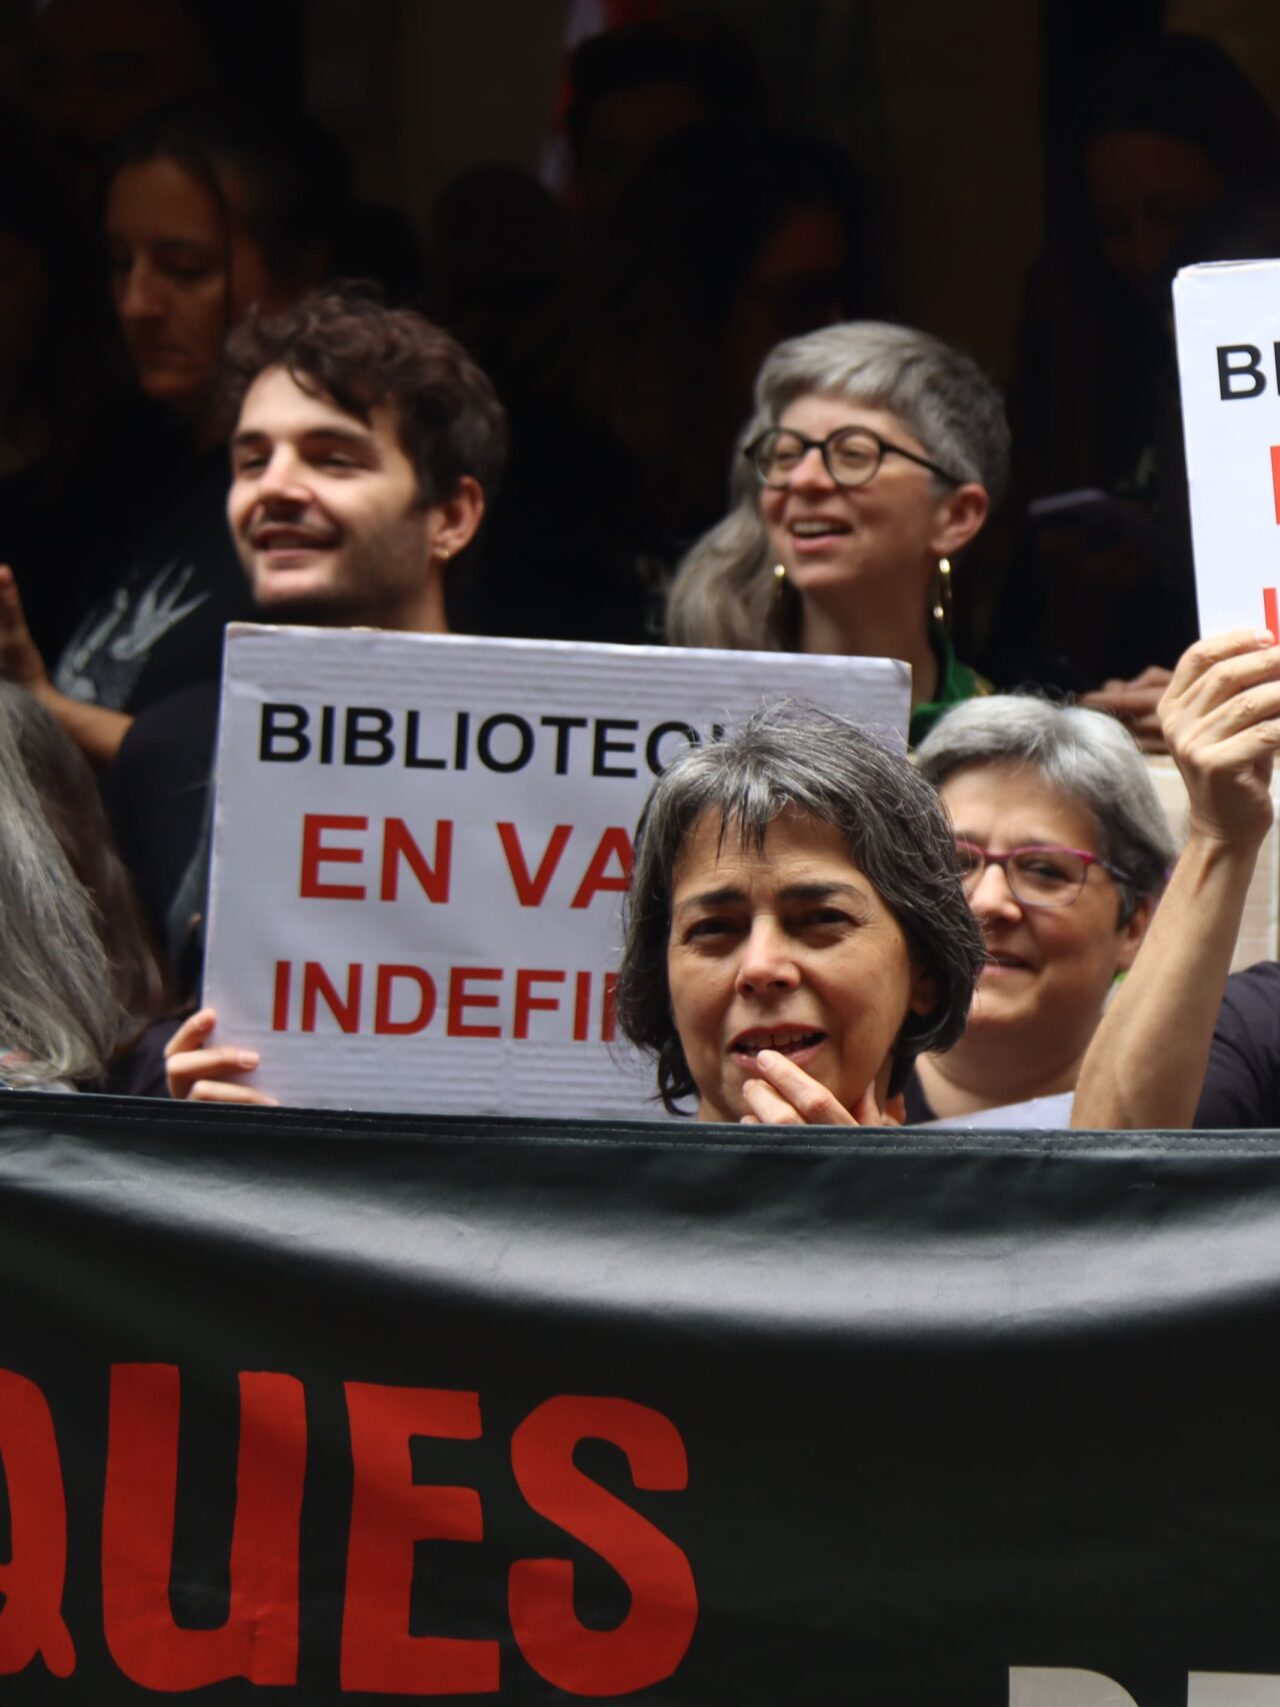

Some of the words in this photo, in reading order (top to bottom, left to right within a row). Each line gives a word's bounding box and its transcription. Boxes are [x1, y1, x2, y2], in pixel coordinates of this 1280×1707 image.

[259, 703, 724, 778] BIBLIOTEQ
[300, 813, 453, 905] EN
[496, 821, 634, 909] VA
[272, 960, 620, 1042] INDEFI
